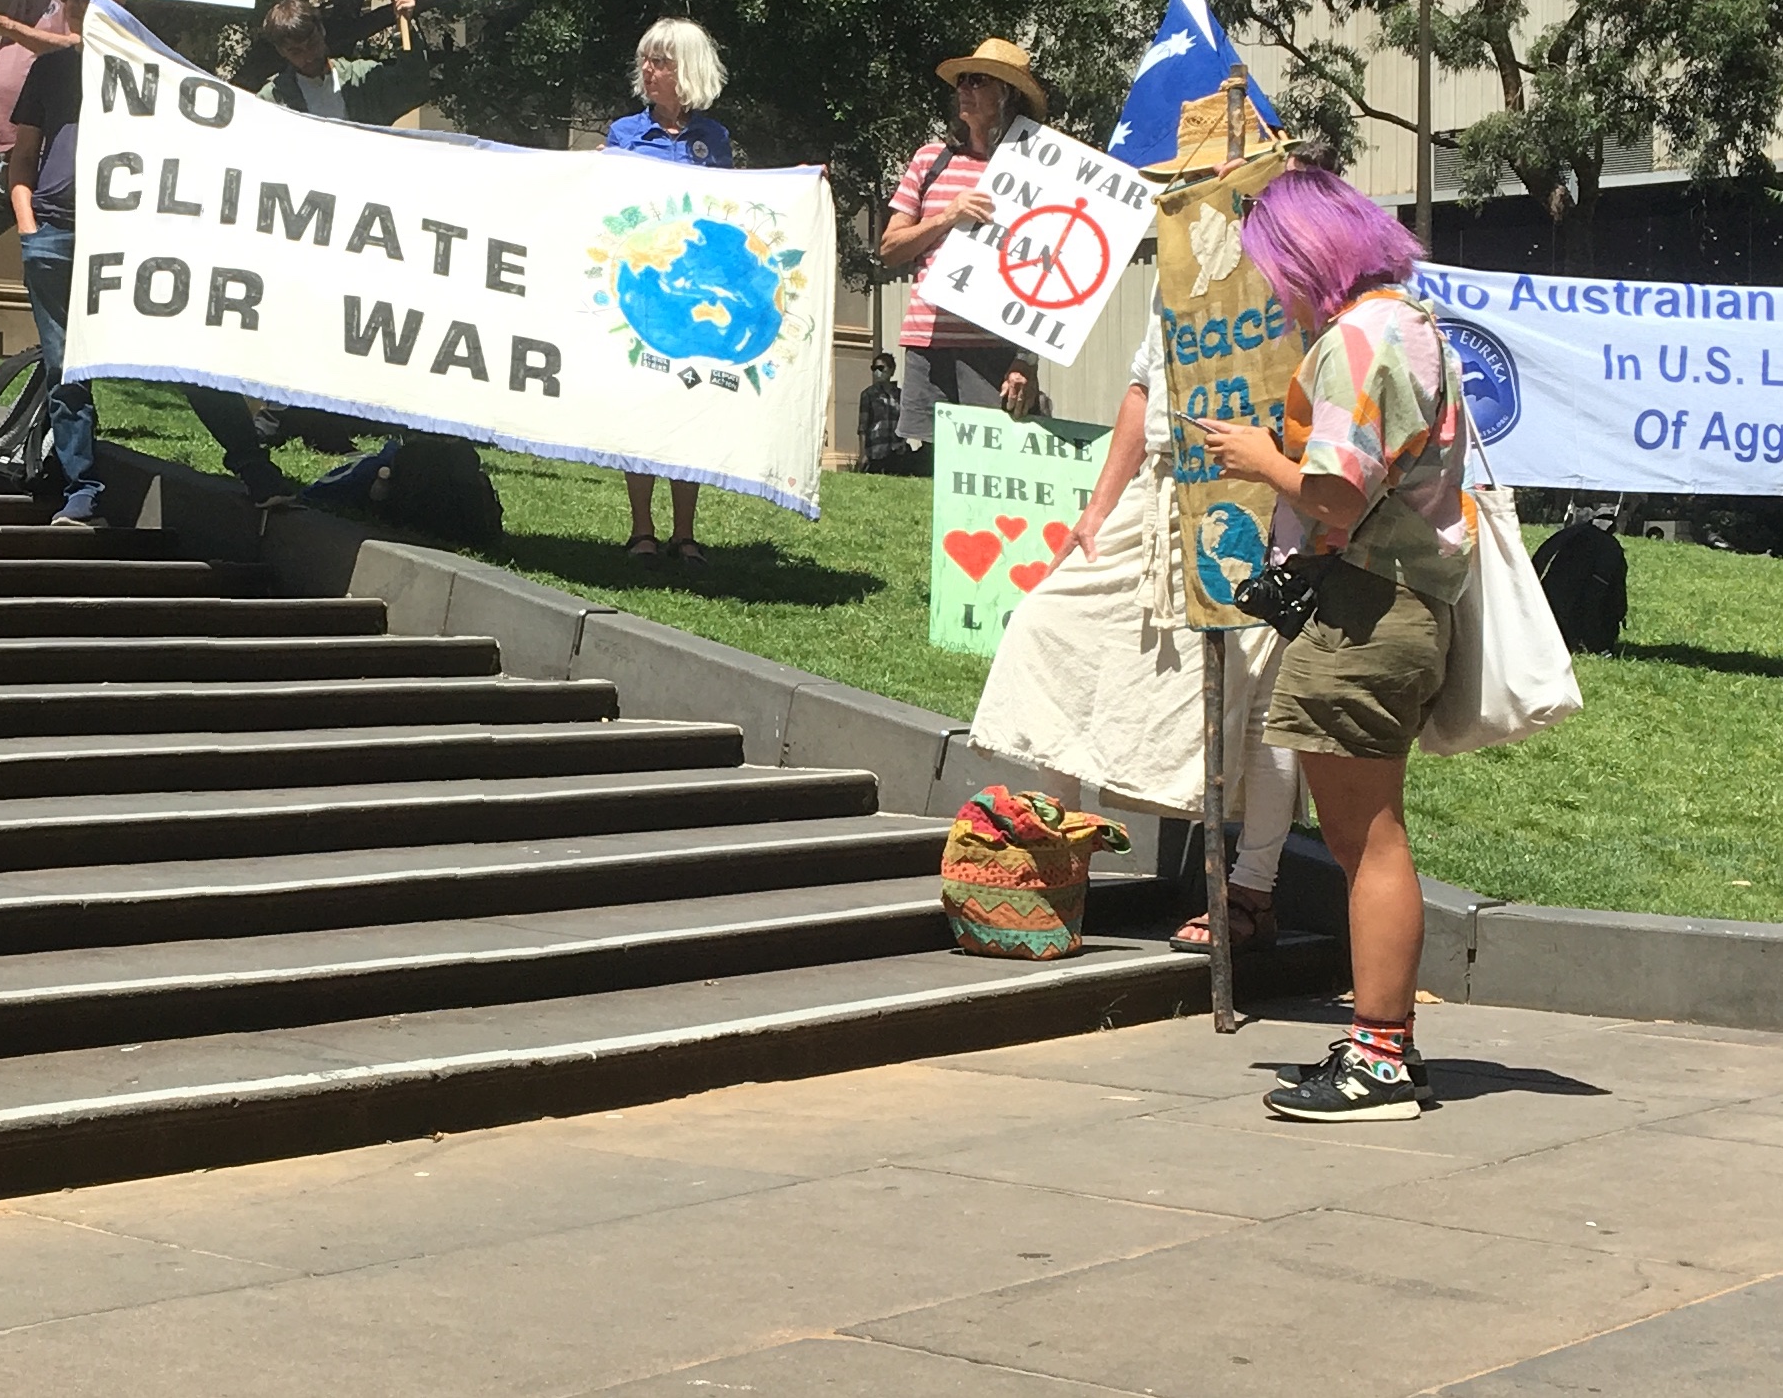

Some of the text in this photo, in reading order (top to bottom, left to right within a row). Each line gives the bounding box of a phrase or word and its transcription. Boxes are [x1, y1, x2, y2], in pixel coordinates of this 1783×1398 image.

[100, 53, 235, 129] NO
[991, 171, 1044, 210] ON
[1009, 128, 1149, 211] NO WAR
[94, 151, 528, 298] CLIMATE
[966, 220, 1063, 275] IRAN
[946, 264, 975, 294] 4
[1418, 272, 1775, 322] No Australian
[85, 251, 564, 399] FOR WAR
[1001, 301, 1067, 351] OIL
[683, 370, 695, 384] 4
[1460, 330, 1508, 384] EUREKA
[1603, 344, 1642, 381] In
[1658, 345, 1744, 385] U.S.
[1187, 375, 1256, 420] on
[1019, 431, 1094, 463] ARE
[1633, 409, 1690, 451] Of
[951, 470, 1056, 507] HERE
